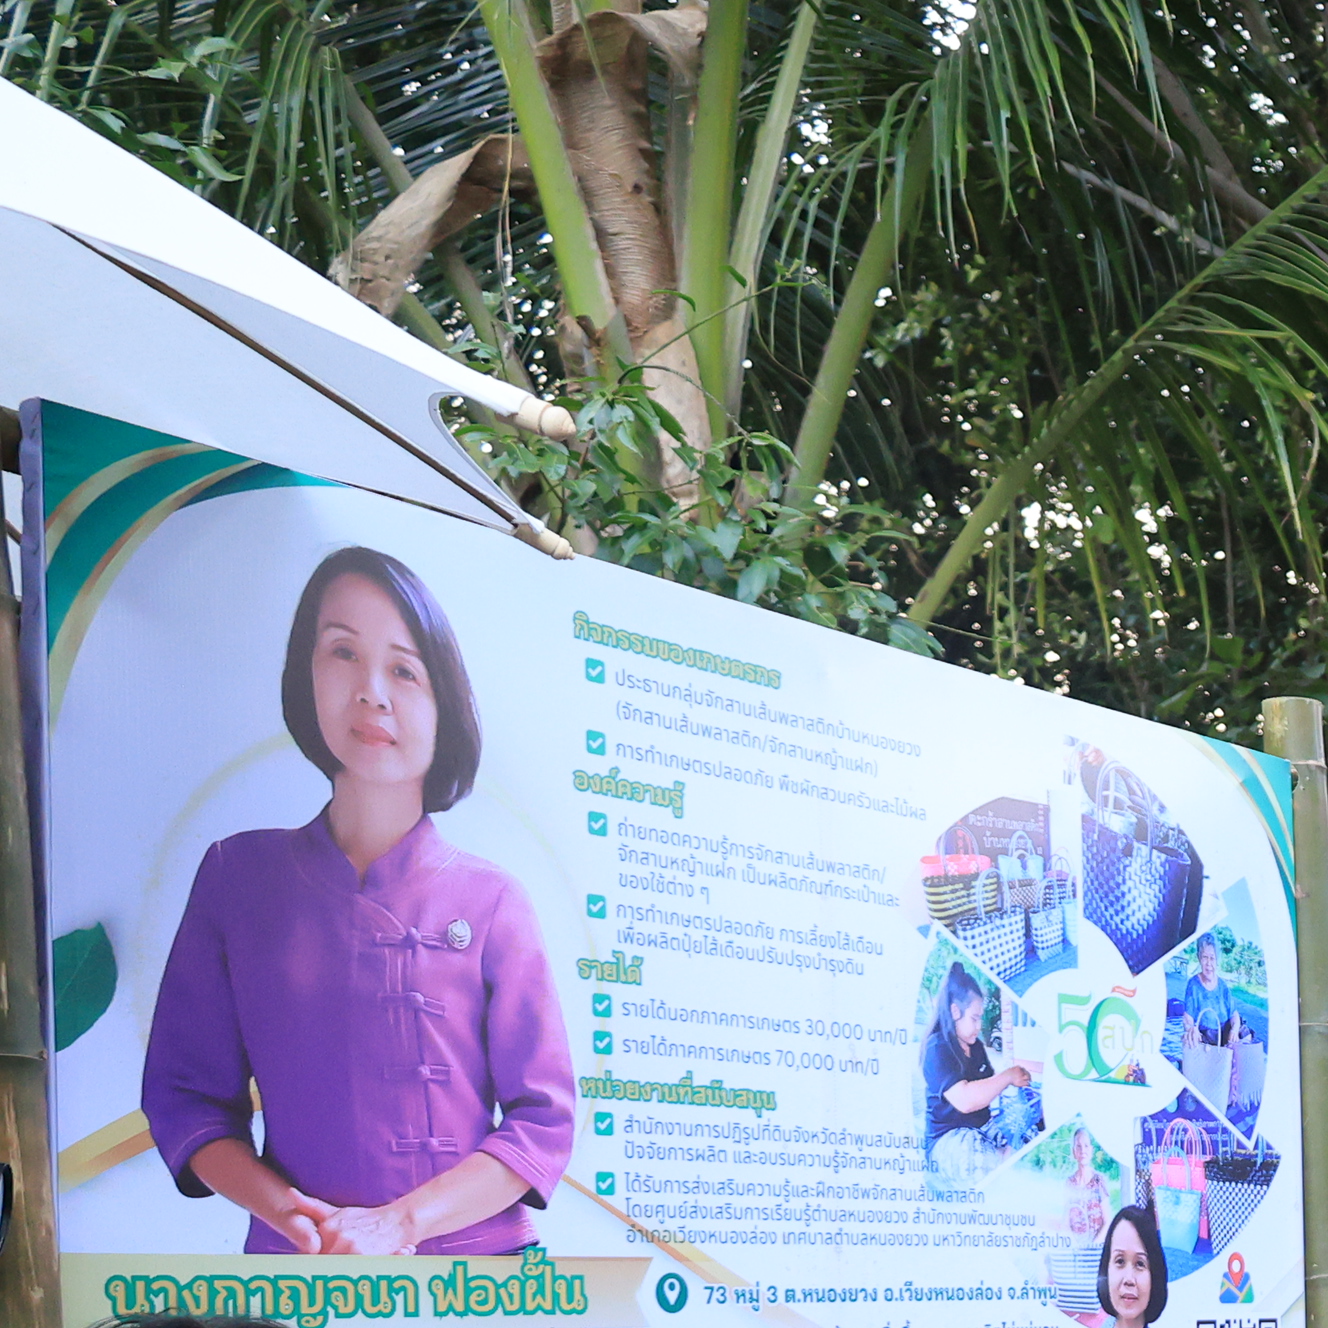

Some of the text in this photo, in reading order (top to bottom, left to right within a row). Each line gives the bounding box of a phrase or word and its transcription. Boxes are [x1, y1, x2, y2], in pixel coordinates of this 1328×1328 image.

[573, 610, 781, 690] กิจกรรมของเกษตรกร
[573, 766, 685, 819] องค์ความรู้
[615, 739, 927, 822] การทำเกษตรปลอดภัย พืชผักสวนครัวและไม้ผล
[618, 844, 737, 882] จักสานหญ้าแฝก
[618, 871, 710, 906] ของใช้ต่าง ๆ
[616, 901, 884, 956] การทำเกษตรปลอดภัย การเลี้ยงไส้เดือน
[576, 950, 643, 986] รายได้
[621, 999, 908, 1047] รายได้นอกภาคการเกษตร 30,000 บาท/ปี
[622, 1036, 880, 1077] รายได้ภาคการเกษตร 70,000 บาท/ปี
[579, 1070, 777, 1119] หน่วยงานที่สนับสนุน
[624, 1140, 727, 1163] ปัจจัยการผลิต
[626, 1222, 1071, 1251] อำเภอเวียงหนองล่อง เทศบาลตำบลหนองยวง มหาวิทยาลัยราชภัฏลำปาง
[912, 1207, 1036, 1230] สำนักงานพัฒนาชุมชน
[430, 1246, 588, 1319] ฟองฝั้น
[704, 1279, 1058, 1311] 73 หมู่ 3 ต.หนองยวง อ.เวียงหนองล่อง จ.ลำพูน
